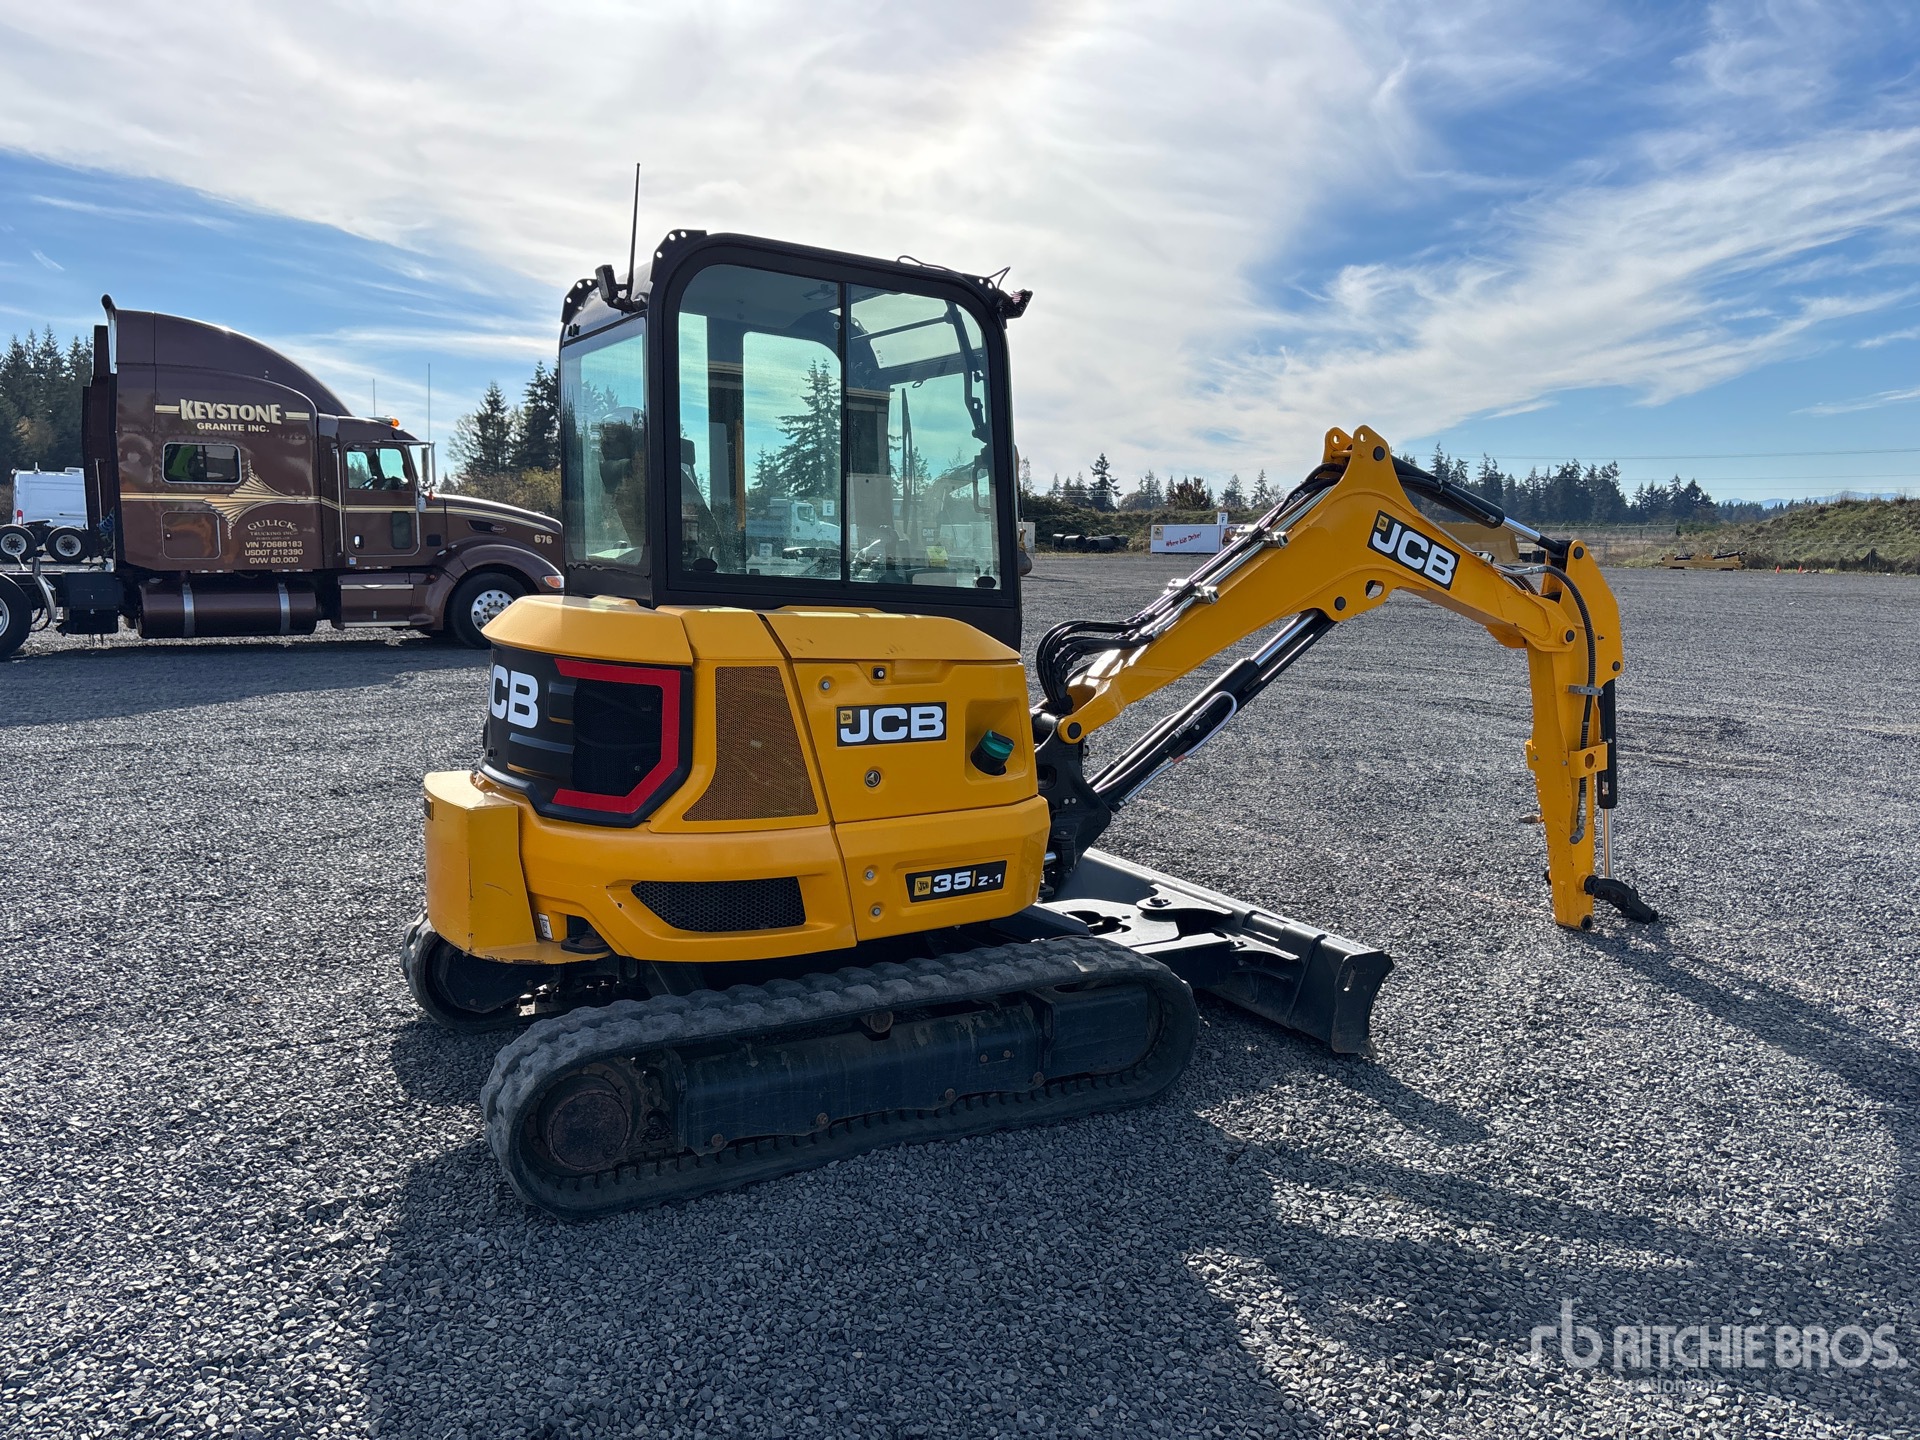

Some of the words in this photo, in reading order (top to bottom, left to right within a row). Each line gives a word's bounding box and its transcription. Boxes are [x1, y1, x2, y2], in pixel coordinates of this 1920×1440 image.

[180, 399, 282, 425] KEYSTONE
[197, 422, 245, 432] GRANITE
[248, 423, 270, 432] INC.
[247, 519, 298, 532] GULICK
[245, 541, 260, 549] VIN
[534, 534, 553, 545] 676
[244, 549, 271, 557] USDOT
[272, 548, 304, 556] 212390
[1372, 522, 1456, 585] JCB
[488, 662, 539, 729] CB
[839, 705, 944, 743] JCB
[932, 870, 972, 893] 35
